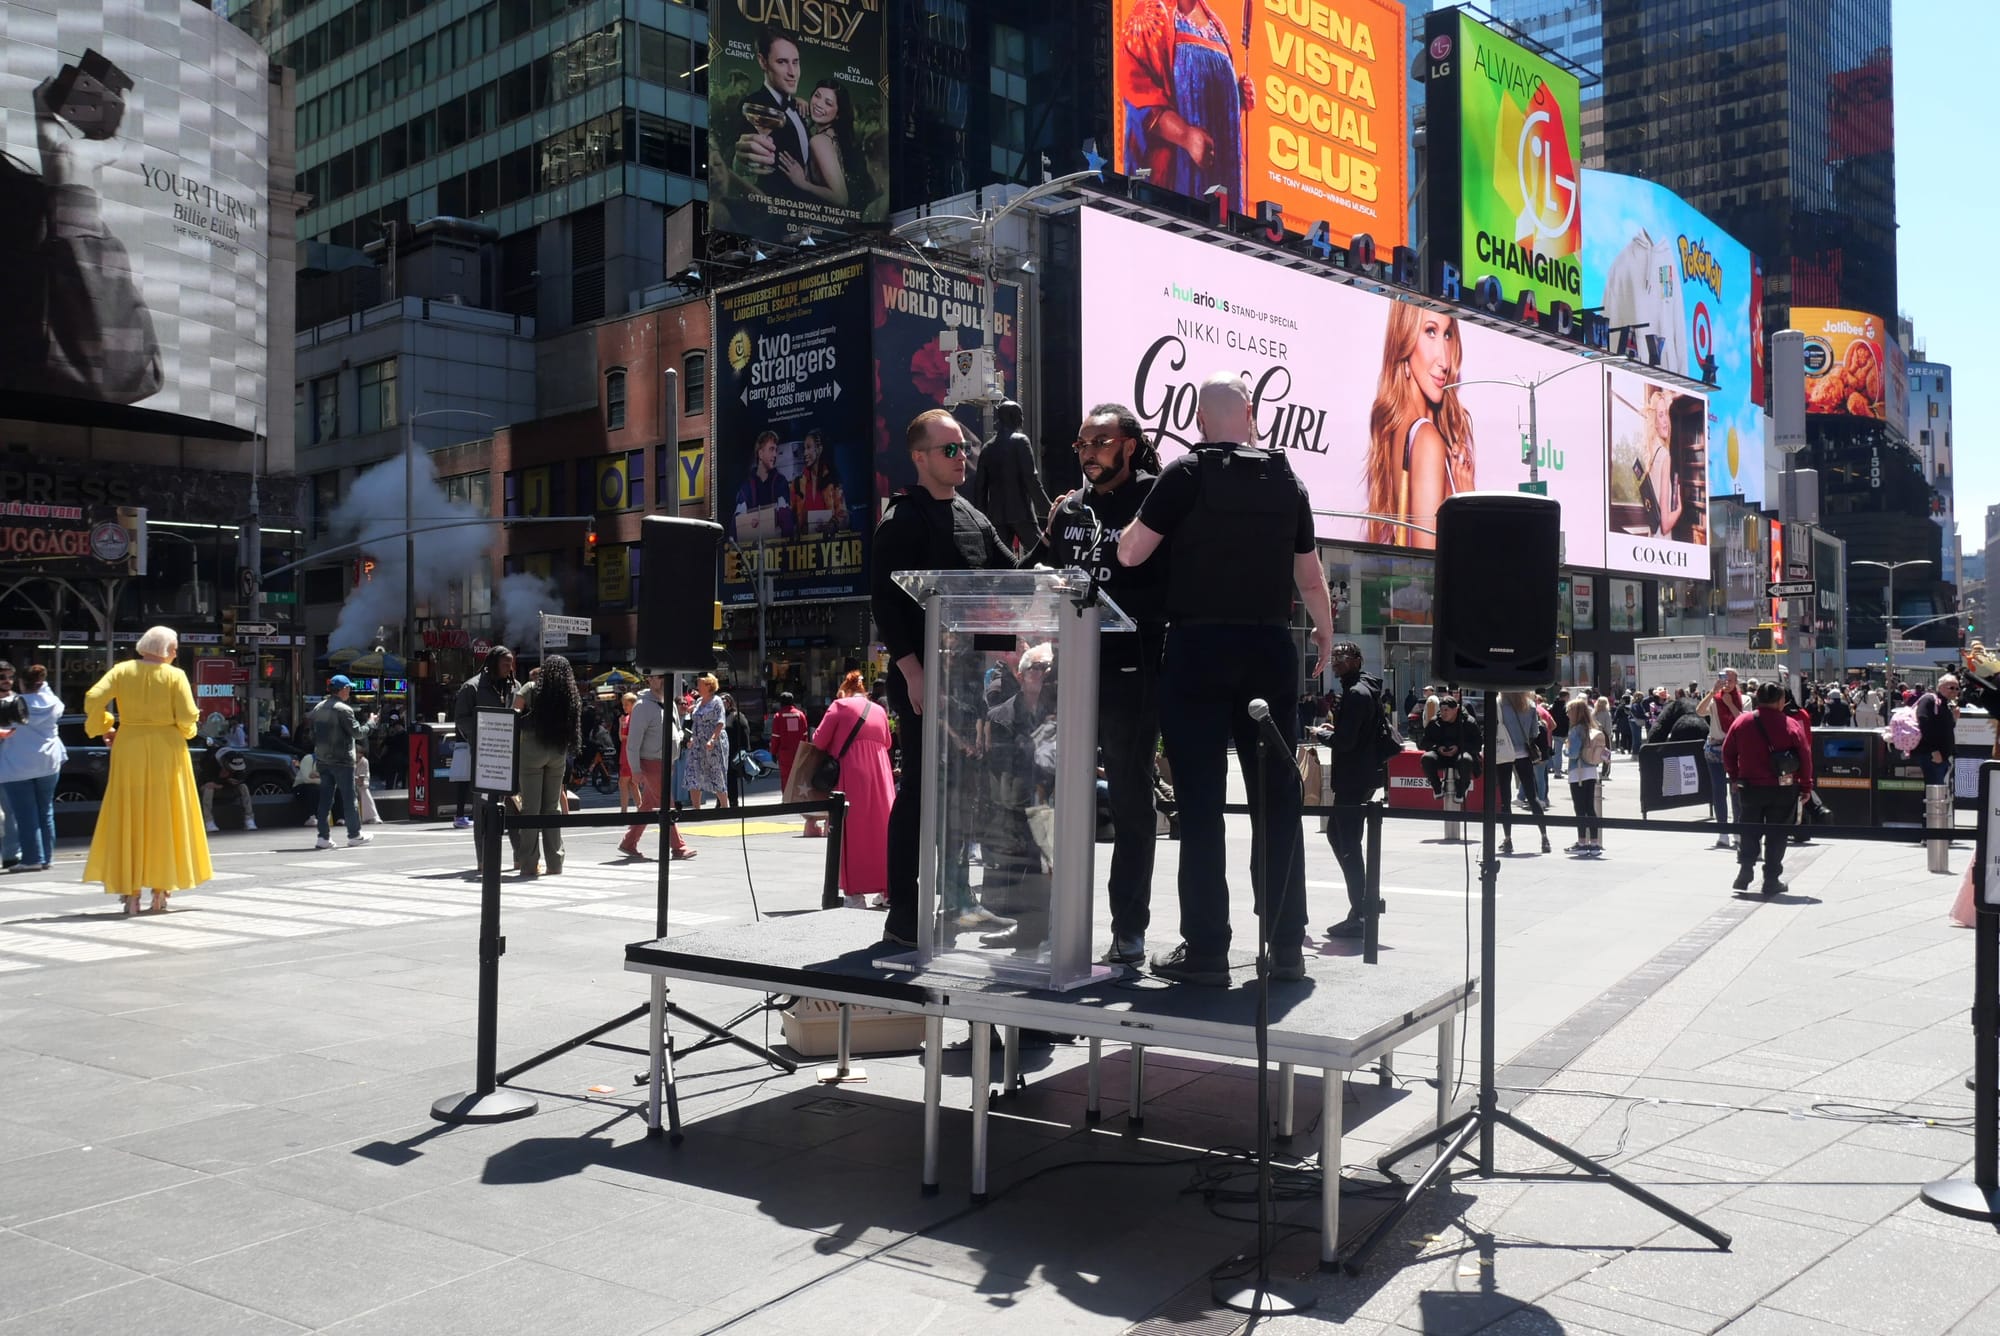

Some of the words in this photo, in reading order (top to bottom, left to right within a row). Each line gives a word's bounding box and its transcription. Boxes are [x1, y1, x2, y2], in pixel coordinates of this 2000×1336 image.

[725, 48, 755, 61] CARNEY
[728, 40, 751, 51] REEVE
[804, 37, 820, 46] NEW
[821, 40, 850, 52] MUSICAL
[834, 72, 874, 86] NOBLEZADA
[847, 66, 861, 75] EVA
[1264, 20, 1376, 110] VISTA
[1431, 62, 1450, 79] LG
[1474, 44, 1545, 106] ALWAYS
[1265, 75, 1377, 155] SOCIAL
[1268, 125, 1378, 202] CLUB
[140, 163, 200, 204] YOUR
[202, 185, 247, 223] TURN
[1268, 170, 1281, 183] THE
[1283, 176, 1300, 189] TONY
[1300, 183, 1352, 209] AWARD-WINNING
[1351, 203, 1378, 218] MUSICAL
[173, 202, 208, 228] Billie
[210, 217, 240, 243] Eilish
[774, 197, 822, 213] BROADWAY
[823, 206, 861, 219] THEATRE
[789, 210, 797, 218] &
[798, 210, 845, 225] BROADWAY
[173, 224, 186, 234] THE
[1476, 230, 1581, 296] CHANGING
[734, 286, 781, 307] EFFERVESCENT
[782, 281, 799, 296] NEW
[799, 274, 830, 291] MUSICAL
[830, 263, 864, 283] COMEDY!
[902, 267, 930, 292] COME
[933, 274, 951, 297] SEE
[953, 280, 973, 302] HOW
[882, 284, 938, 319] WORLD
[942, 299, 984, 331] COUL
[993, 312, 1012, 336] BE
[1163, 287, 1170, 297] A
[1172, 281, 1230, 313] hularious
[1231, 304, 1268, 322] STAND-UP
[1269, 315, 1298, 330] SPECIAL
[1177, 317, 1220, 345] NIKKI
[1226, 330, 1288, 361] GLASER
[1823, 320, 1864, 336] Jollibee
[757, 332, 790, 361] two
[751, 346, 836, 386] strangers
[749, 385, 769, 401] carry
[770, 386, 776, 396] a
[776, 379, 796, 395] cake
[767, 394, 793, 409] across
[794, 390, 812, 403] new
[813, 382, 832, 404] york
[1871, 447, 1880, 488] 1500
[764, 548, 782, 569] OF
[788, 543, 817, 570] THE
[820, 539, 863, 567] YEAR
[1633, 545, 1687, 568] COACH
[1718, 652, 1729, 667] THE
[1730, 652, 1757, 669] ADVANCE
[1758, 654, 1776, 670] GROUP
[197, 684, 235, 698] WELCOME
[1399, 778, 1424, 787] TIMES
